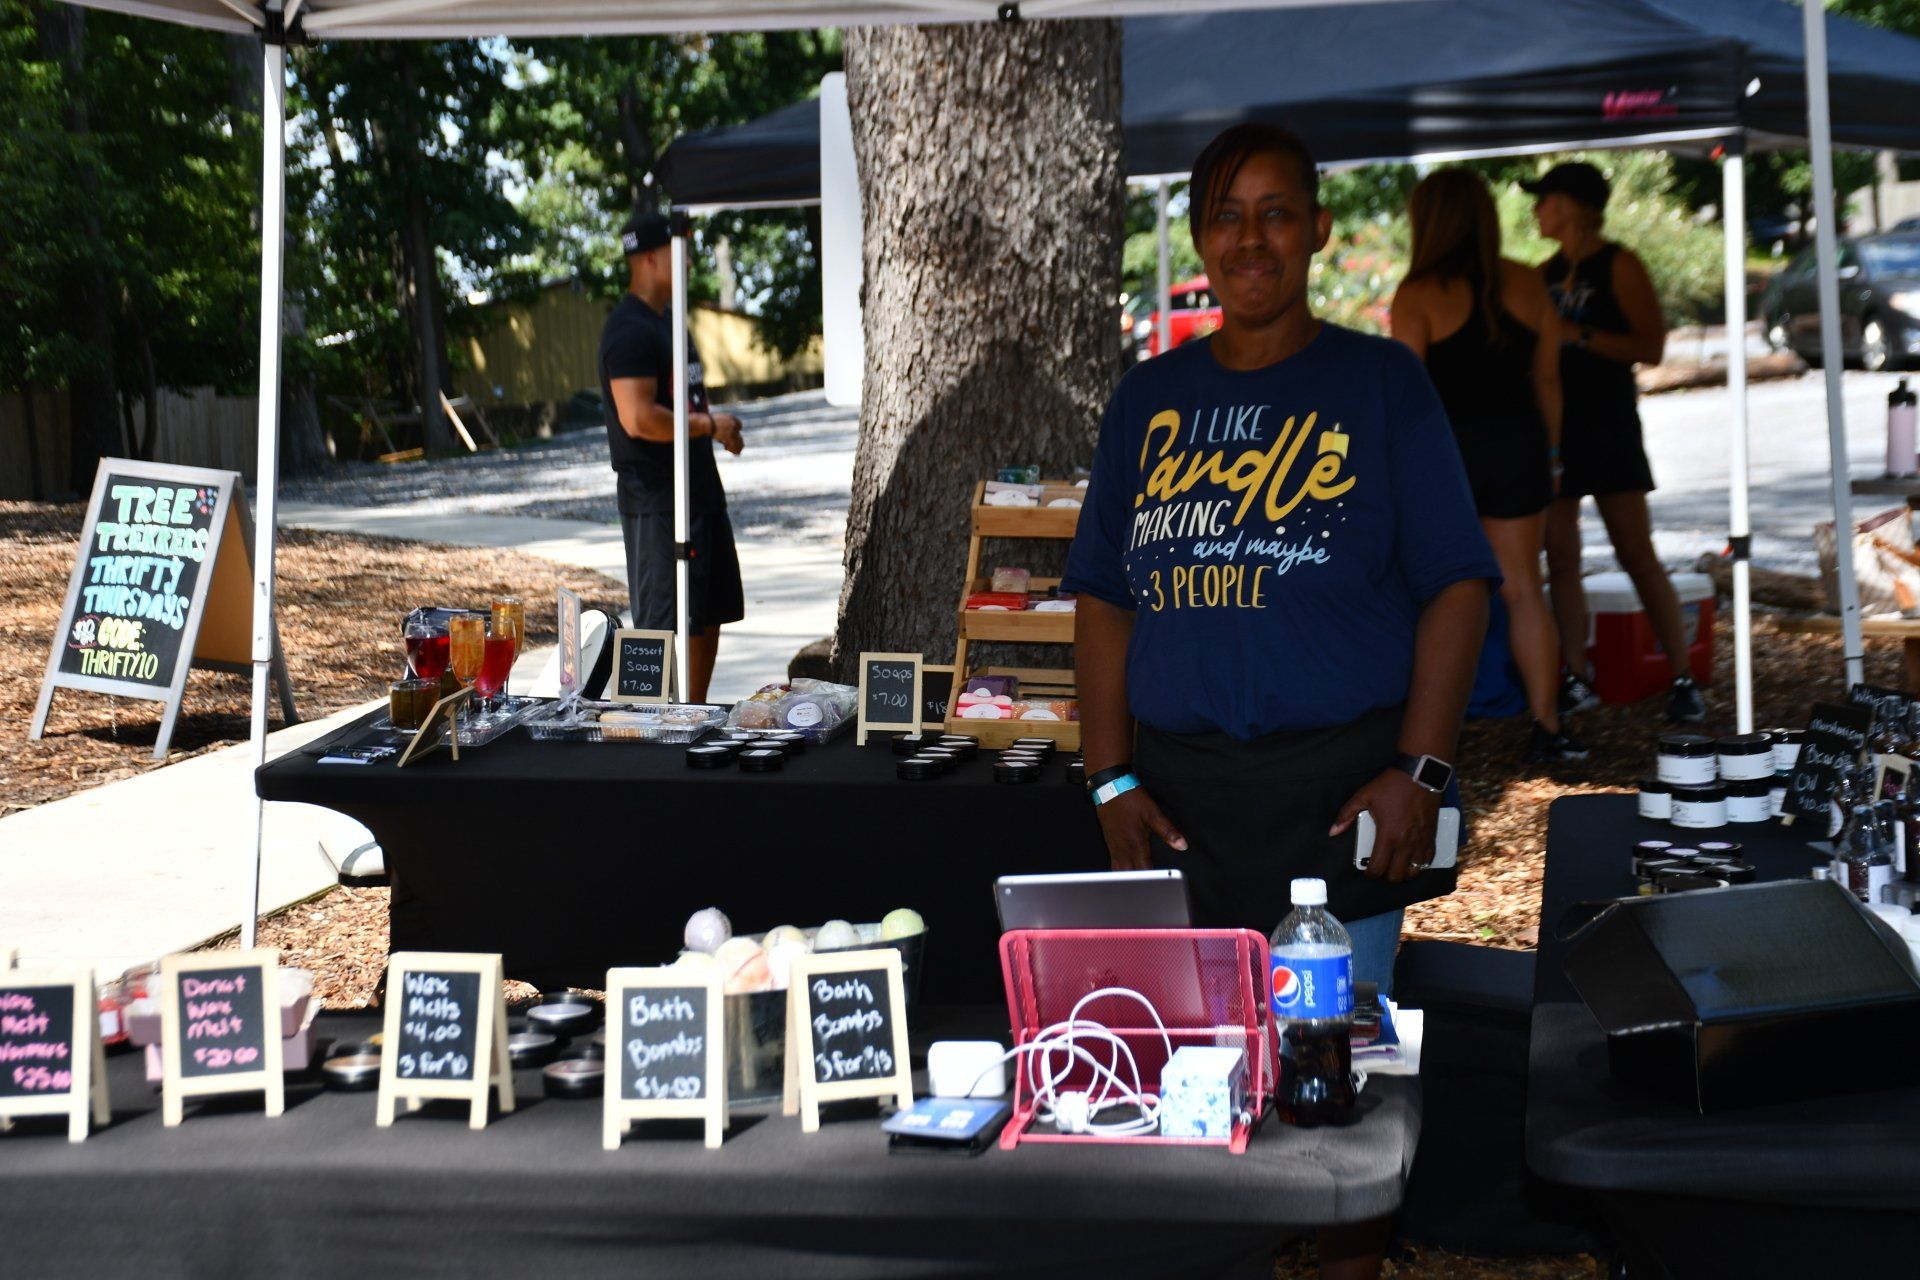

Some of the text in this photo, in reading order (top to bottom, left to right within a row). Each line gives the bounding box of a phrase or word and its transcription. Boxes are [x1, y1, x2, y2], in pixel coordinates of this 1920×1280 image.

[1189, 405, 1272, 445] I LIKE
[111, 484, 198, 525] TREE
[1130, 500, 1232, 551] MAKING
[1193, 529, 1331, 576] and maybe
[91, 555, 185, 593] THRIFTY
[1150, 564, 1273, 612] 3 PEOPLE
[83, 585, 190, 630] THURSDAYS
[80, 648, 159, 680] THRIFTY10
[624, 644, 663, 656] Dessert
[626, 661, 661, 675] Soaps
[872, 665, 913, 683] Soaps
[872, 692, 908, 708] $7.00
[404, 972, 450, 996] Wax
[812, 978, 874, 1004] Bath
[1301, 969, 1316, 1008] pepsi
[630, 995, 695, 1027] Bath
[813, 1008, 883, 1040] Bombs
[404, 1021, 462, 1043] $4.00
[399, 1053, 416, 1077] 3
[627, 1030, 703, 1070] Bombs
[815, 1052, 833, 1081] 3
